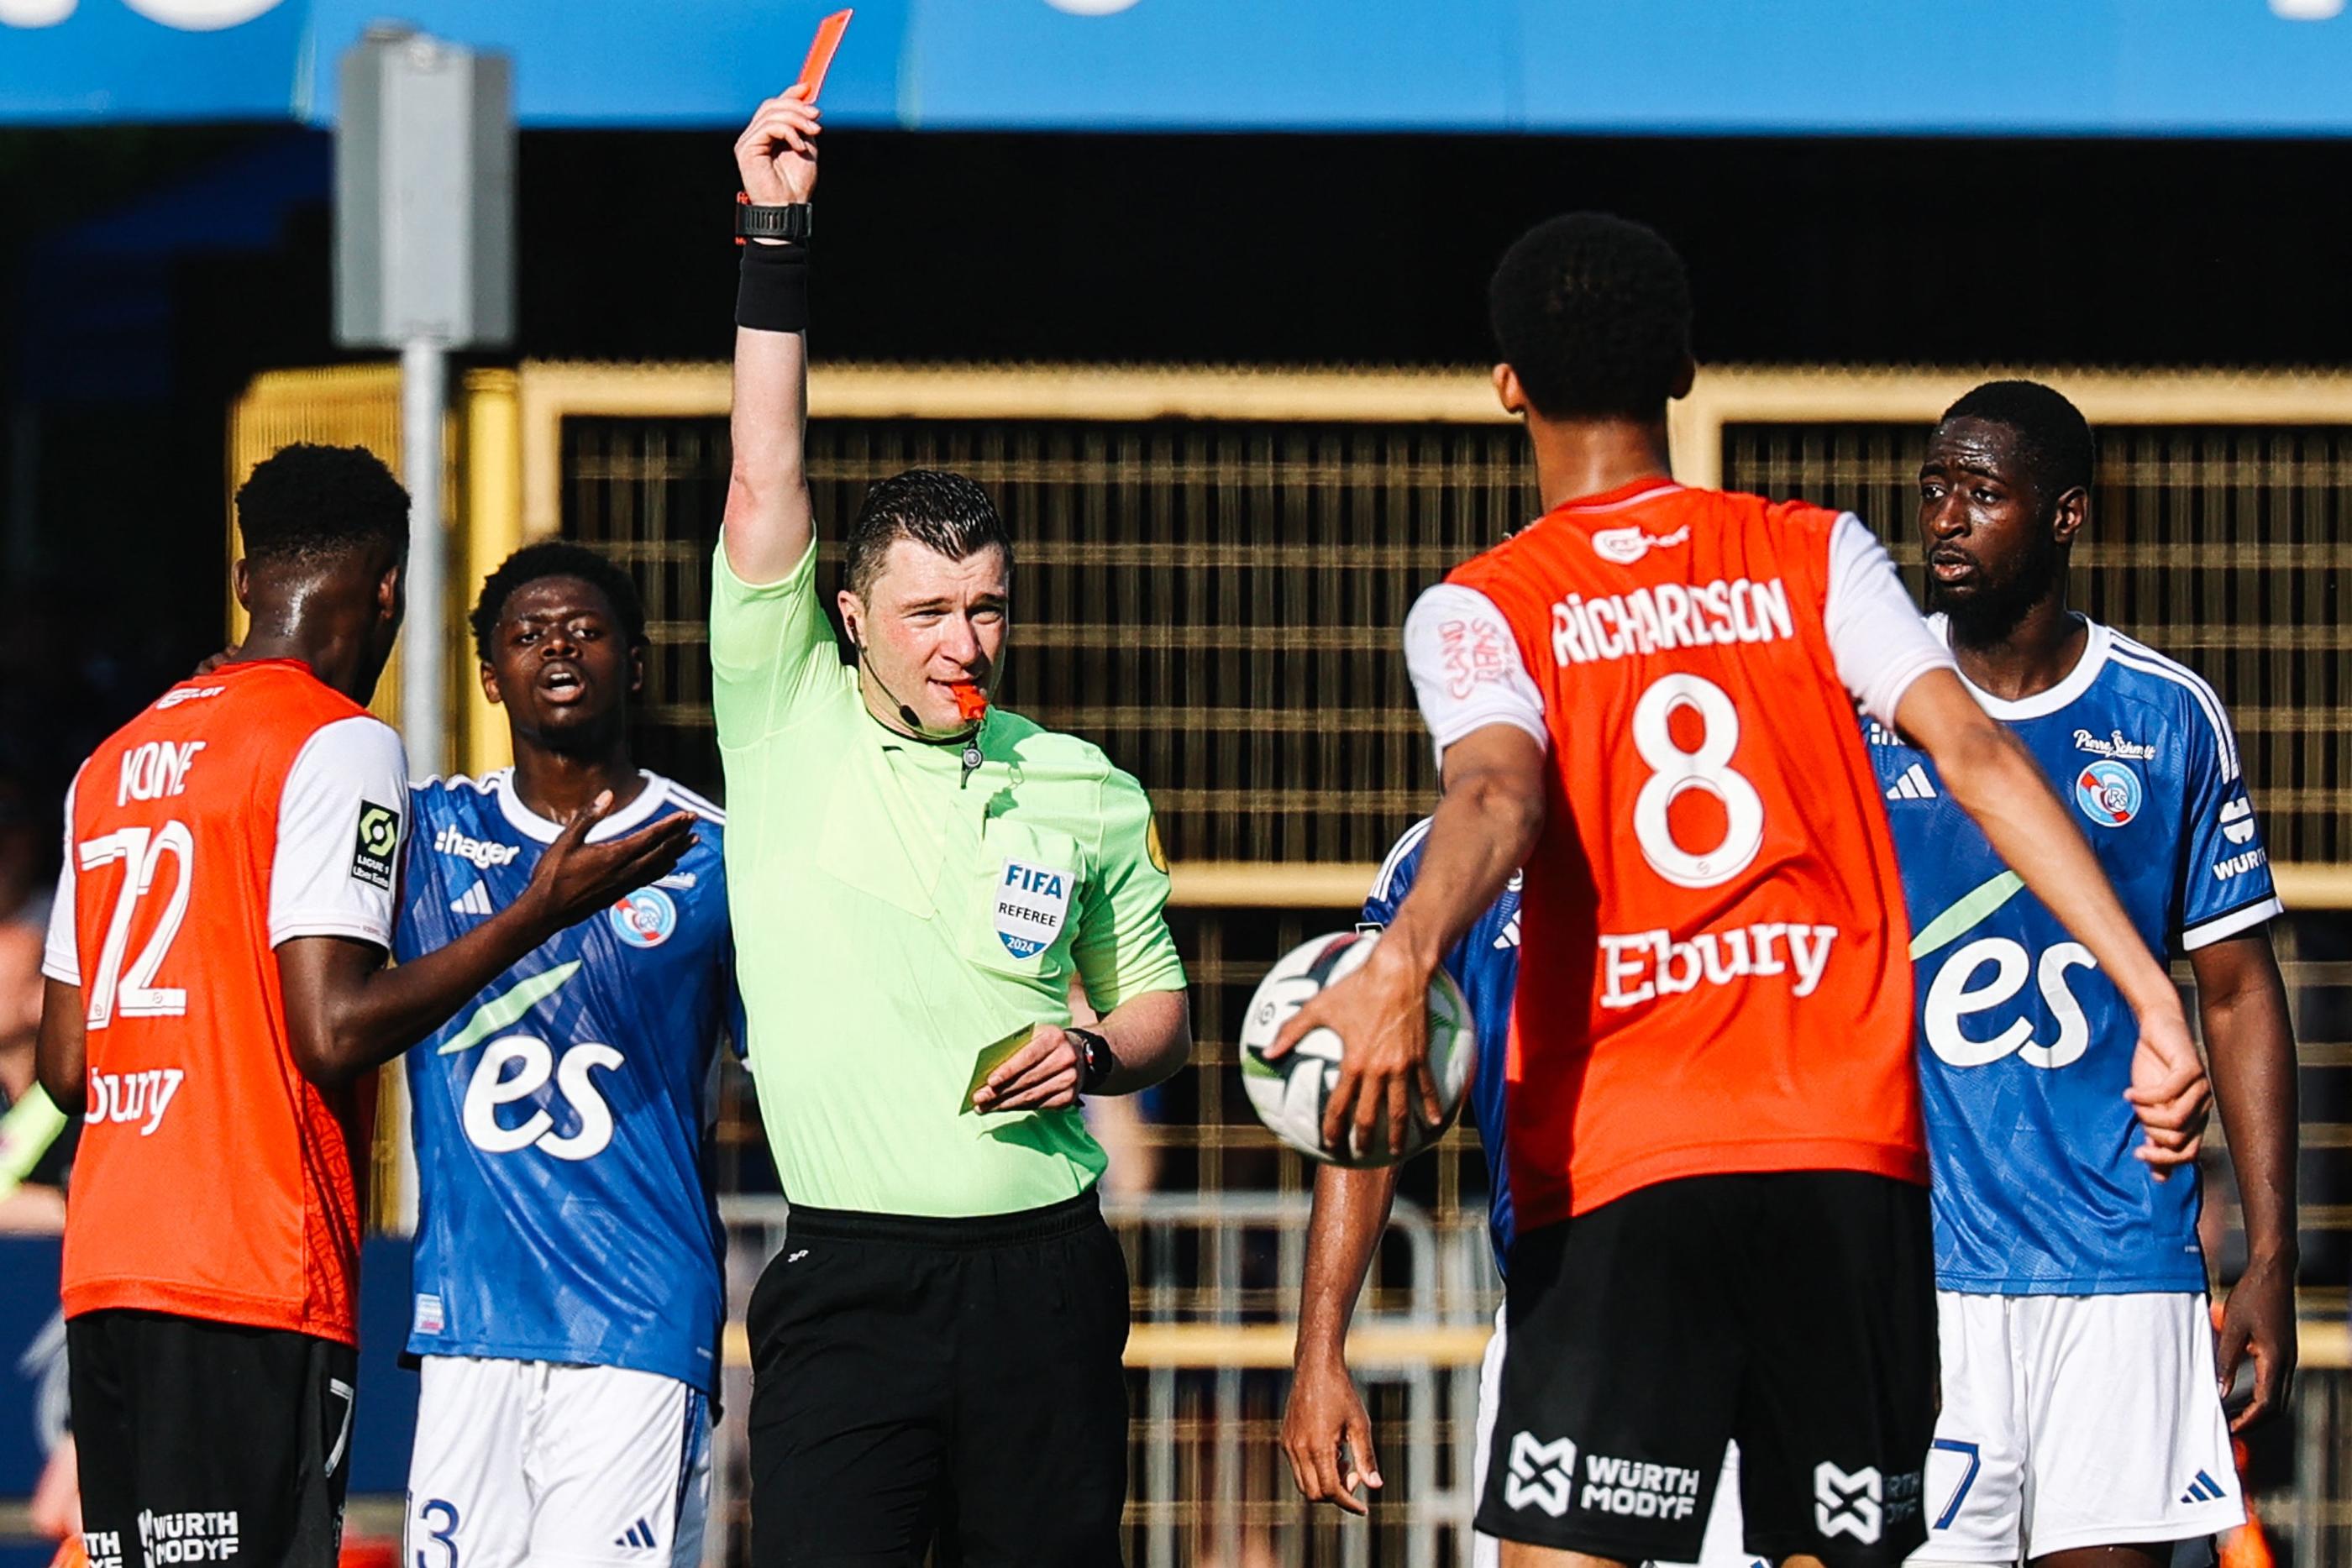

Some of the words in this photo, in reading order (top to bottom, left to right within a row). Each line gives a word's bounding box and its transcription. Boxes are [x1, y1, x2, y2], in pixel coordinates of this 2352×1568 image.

[117, 741, 207, 807] KONE
[1632, 673, 1763, 889] 8
[1005, 864, 1062, 899] FIFA
[78, 820, 194, 1030] 72
[999, 902, 1057, 927] REFEREE
[1008, 936, 1035, 954] 2024
[1599, 922, 1839, 1008] Ebury
[1586, 1454, 1700, 1495] WÜRTH
[1581, 1484, 1695, 1519] MODYF
[155, 1538, 239, 1565] MODYF
